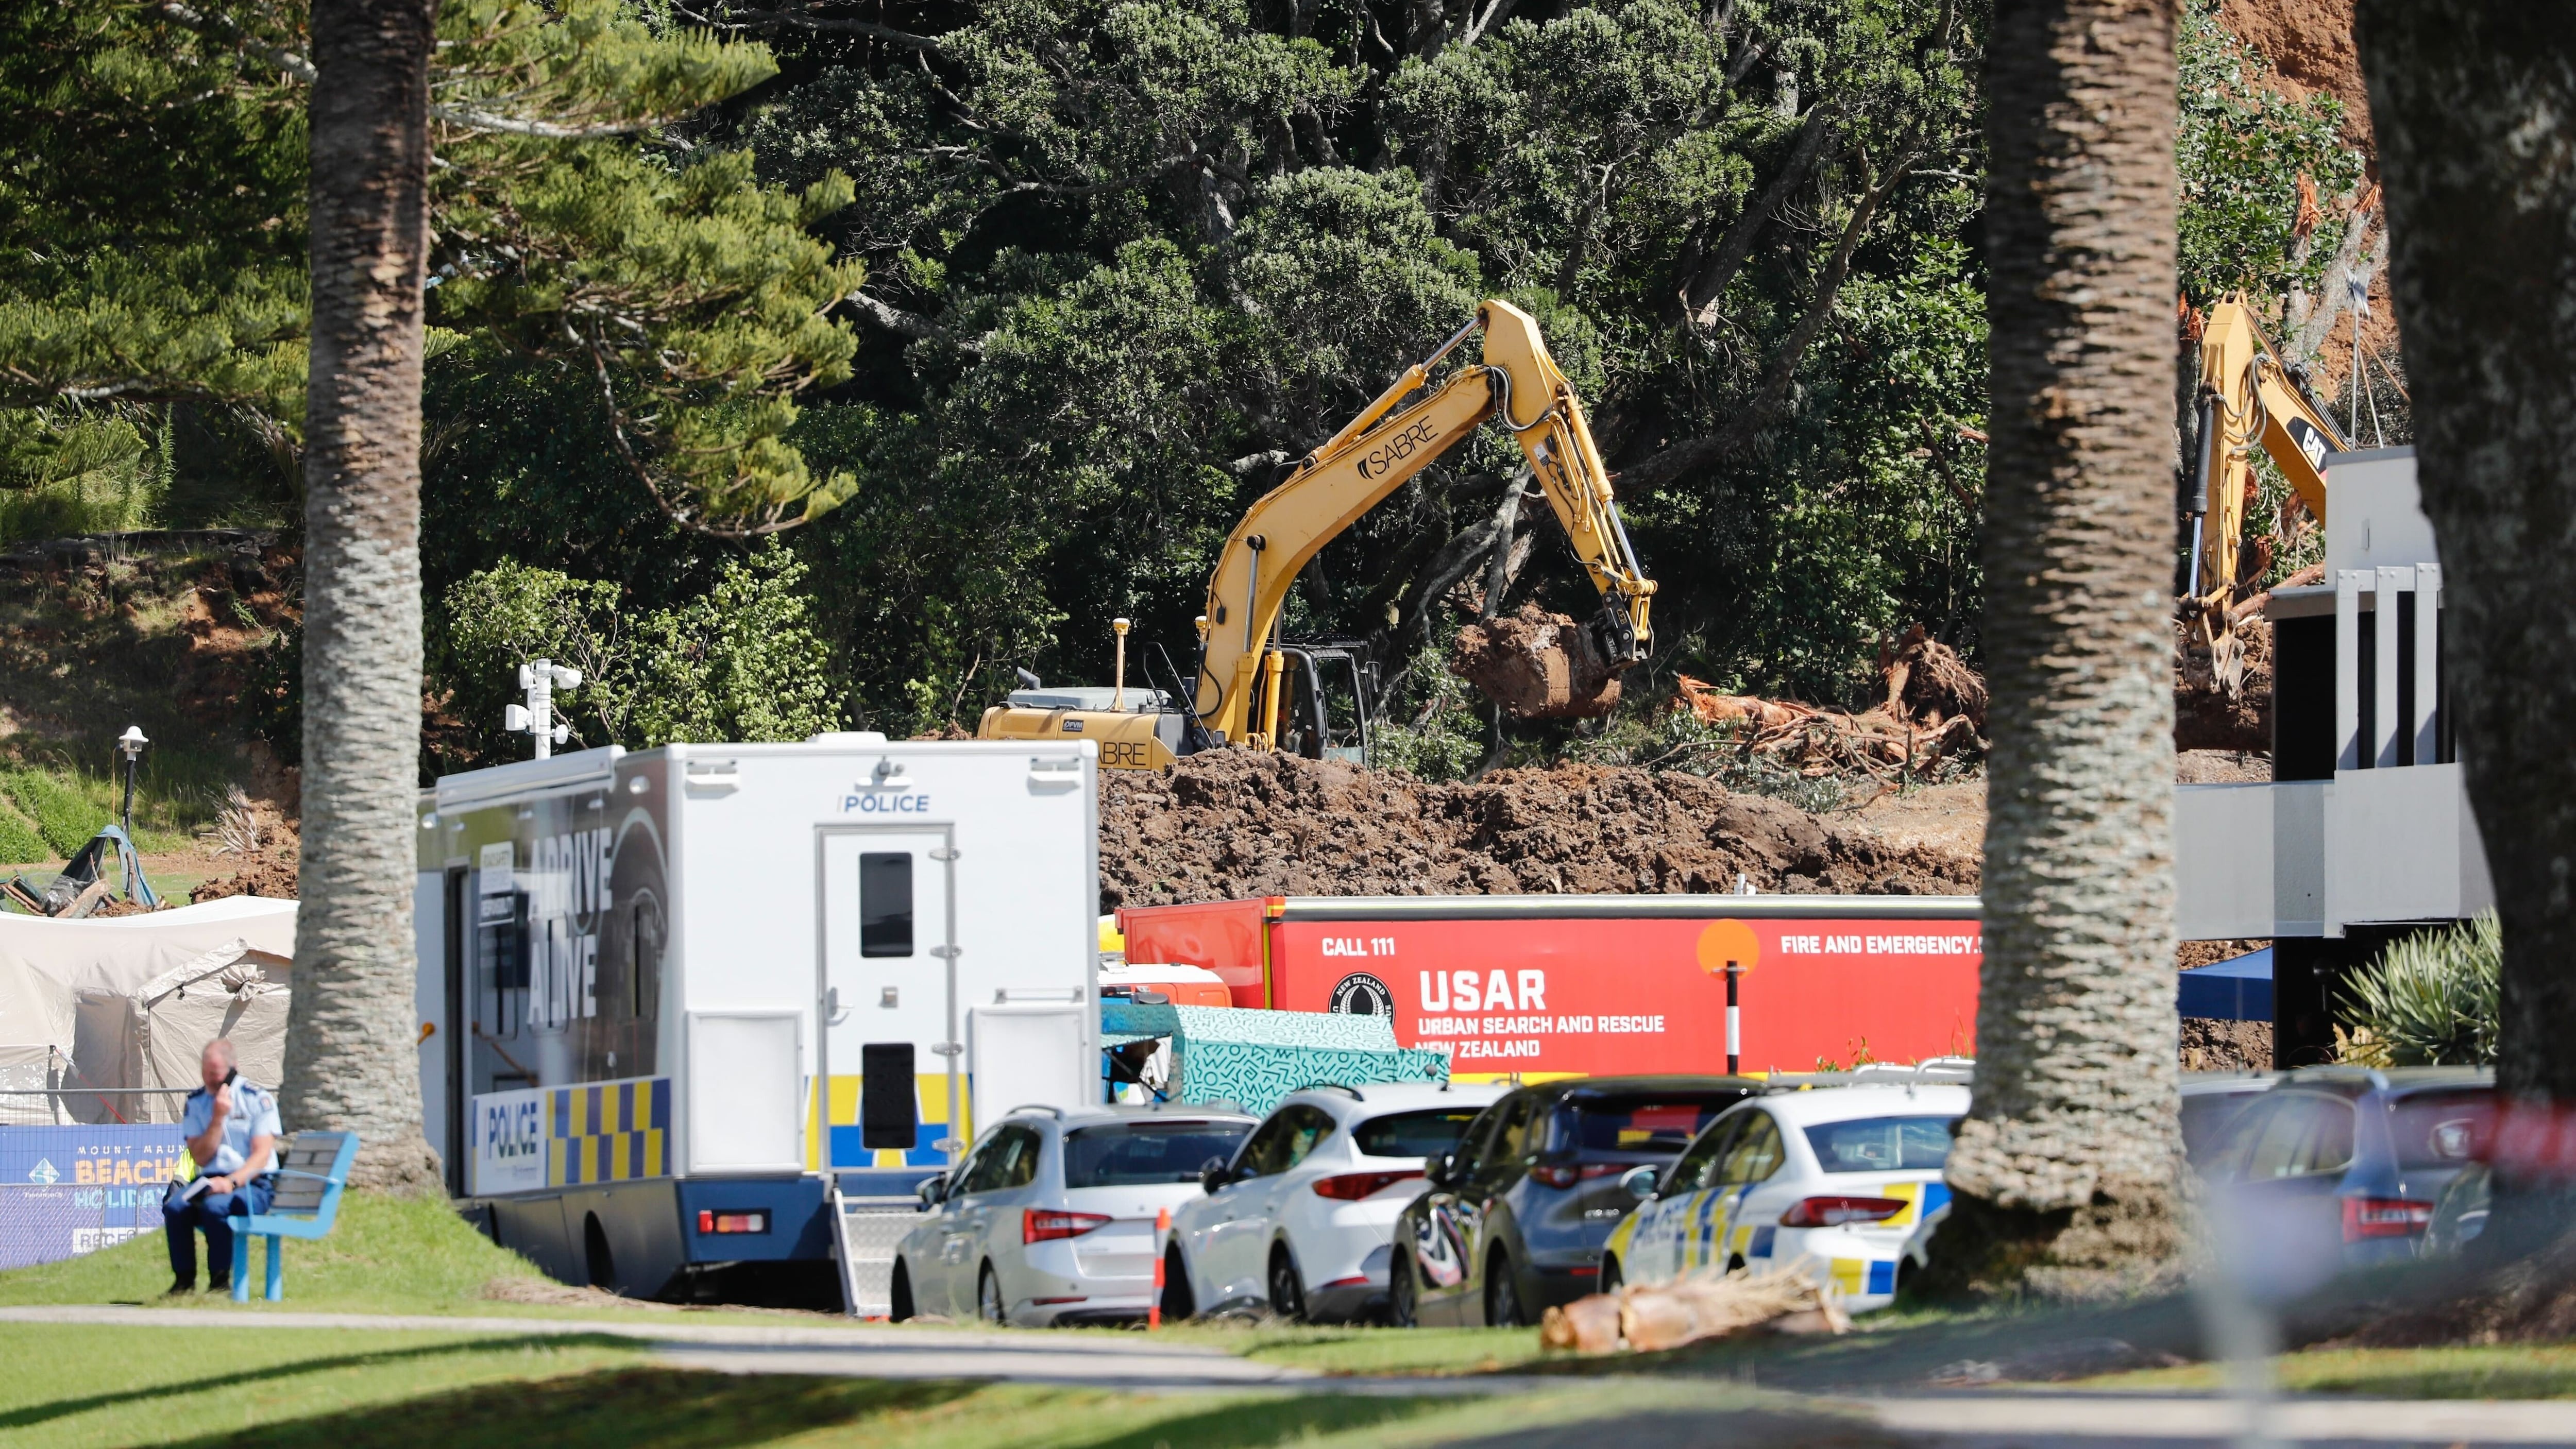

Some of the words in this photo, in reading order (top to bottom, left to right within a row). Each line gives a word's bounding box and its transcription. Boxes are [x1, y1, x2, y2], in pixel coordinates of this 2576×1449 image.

[1369, 415, 1439, 474] SABRE
[2302, 427, 2327, 470] CAT
[845, 794, 929, 812] POLICE
[528, 827, 612, 921] ARRIVE
[1322, 937, 1368, 957] CALL
[1370, 937, 1395, 956] 111
[1781, 935, 1821, 954] FIRE
[1825, 935, 1862, 954] AND
[527, 934, 597, 1025] ALIVE
[1336, 980, 1351, 997] NEW
[1352, 976, 1386, 996] ZEALAND
[1419, 969, 1547, 1012] USAR
[1418, 1017, 1479, 1035] URBAN
[1482, 1016, 1553, 1034] SEARCH
[1556, 1015, 1594, 1034] AND
[1598, 1015, 1665, 1033] RESCUE
[1459, 1039, 1540, 1059] ZEALAND
[488, 1100, 537, 1160] POLICE
[78, 1145, 131, 1155] MOUNT
[75, 1157, 178, 1185] BEACH
